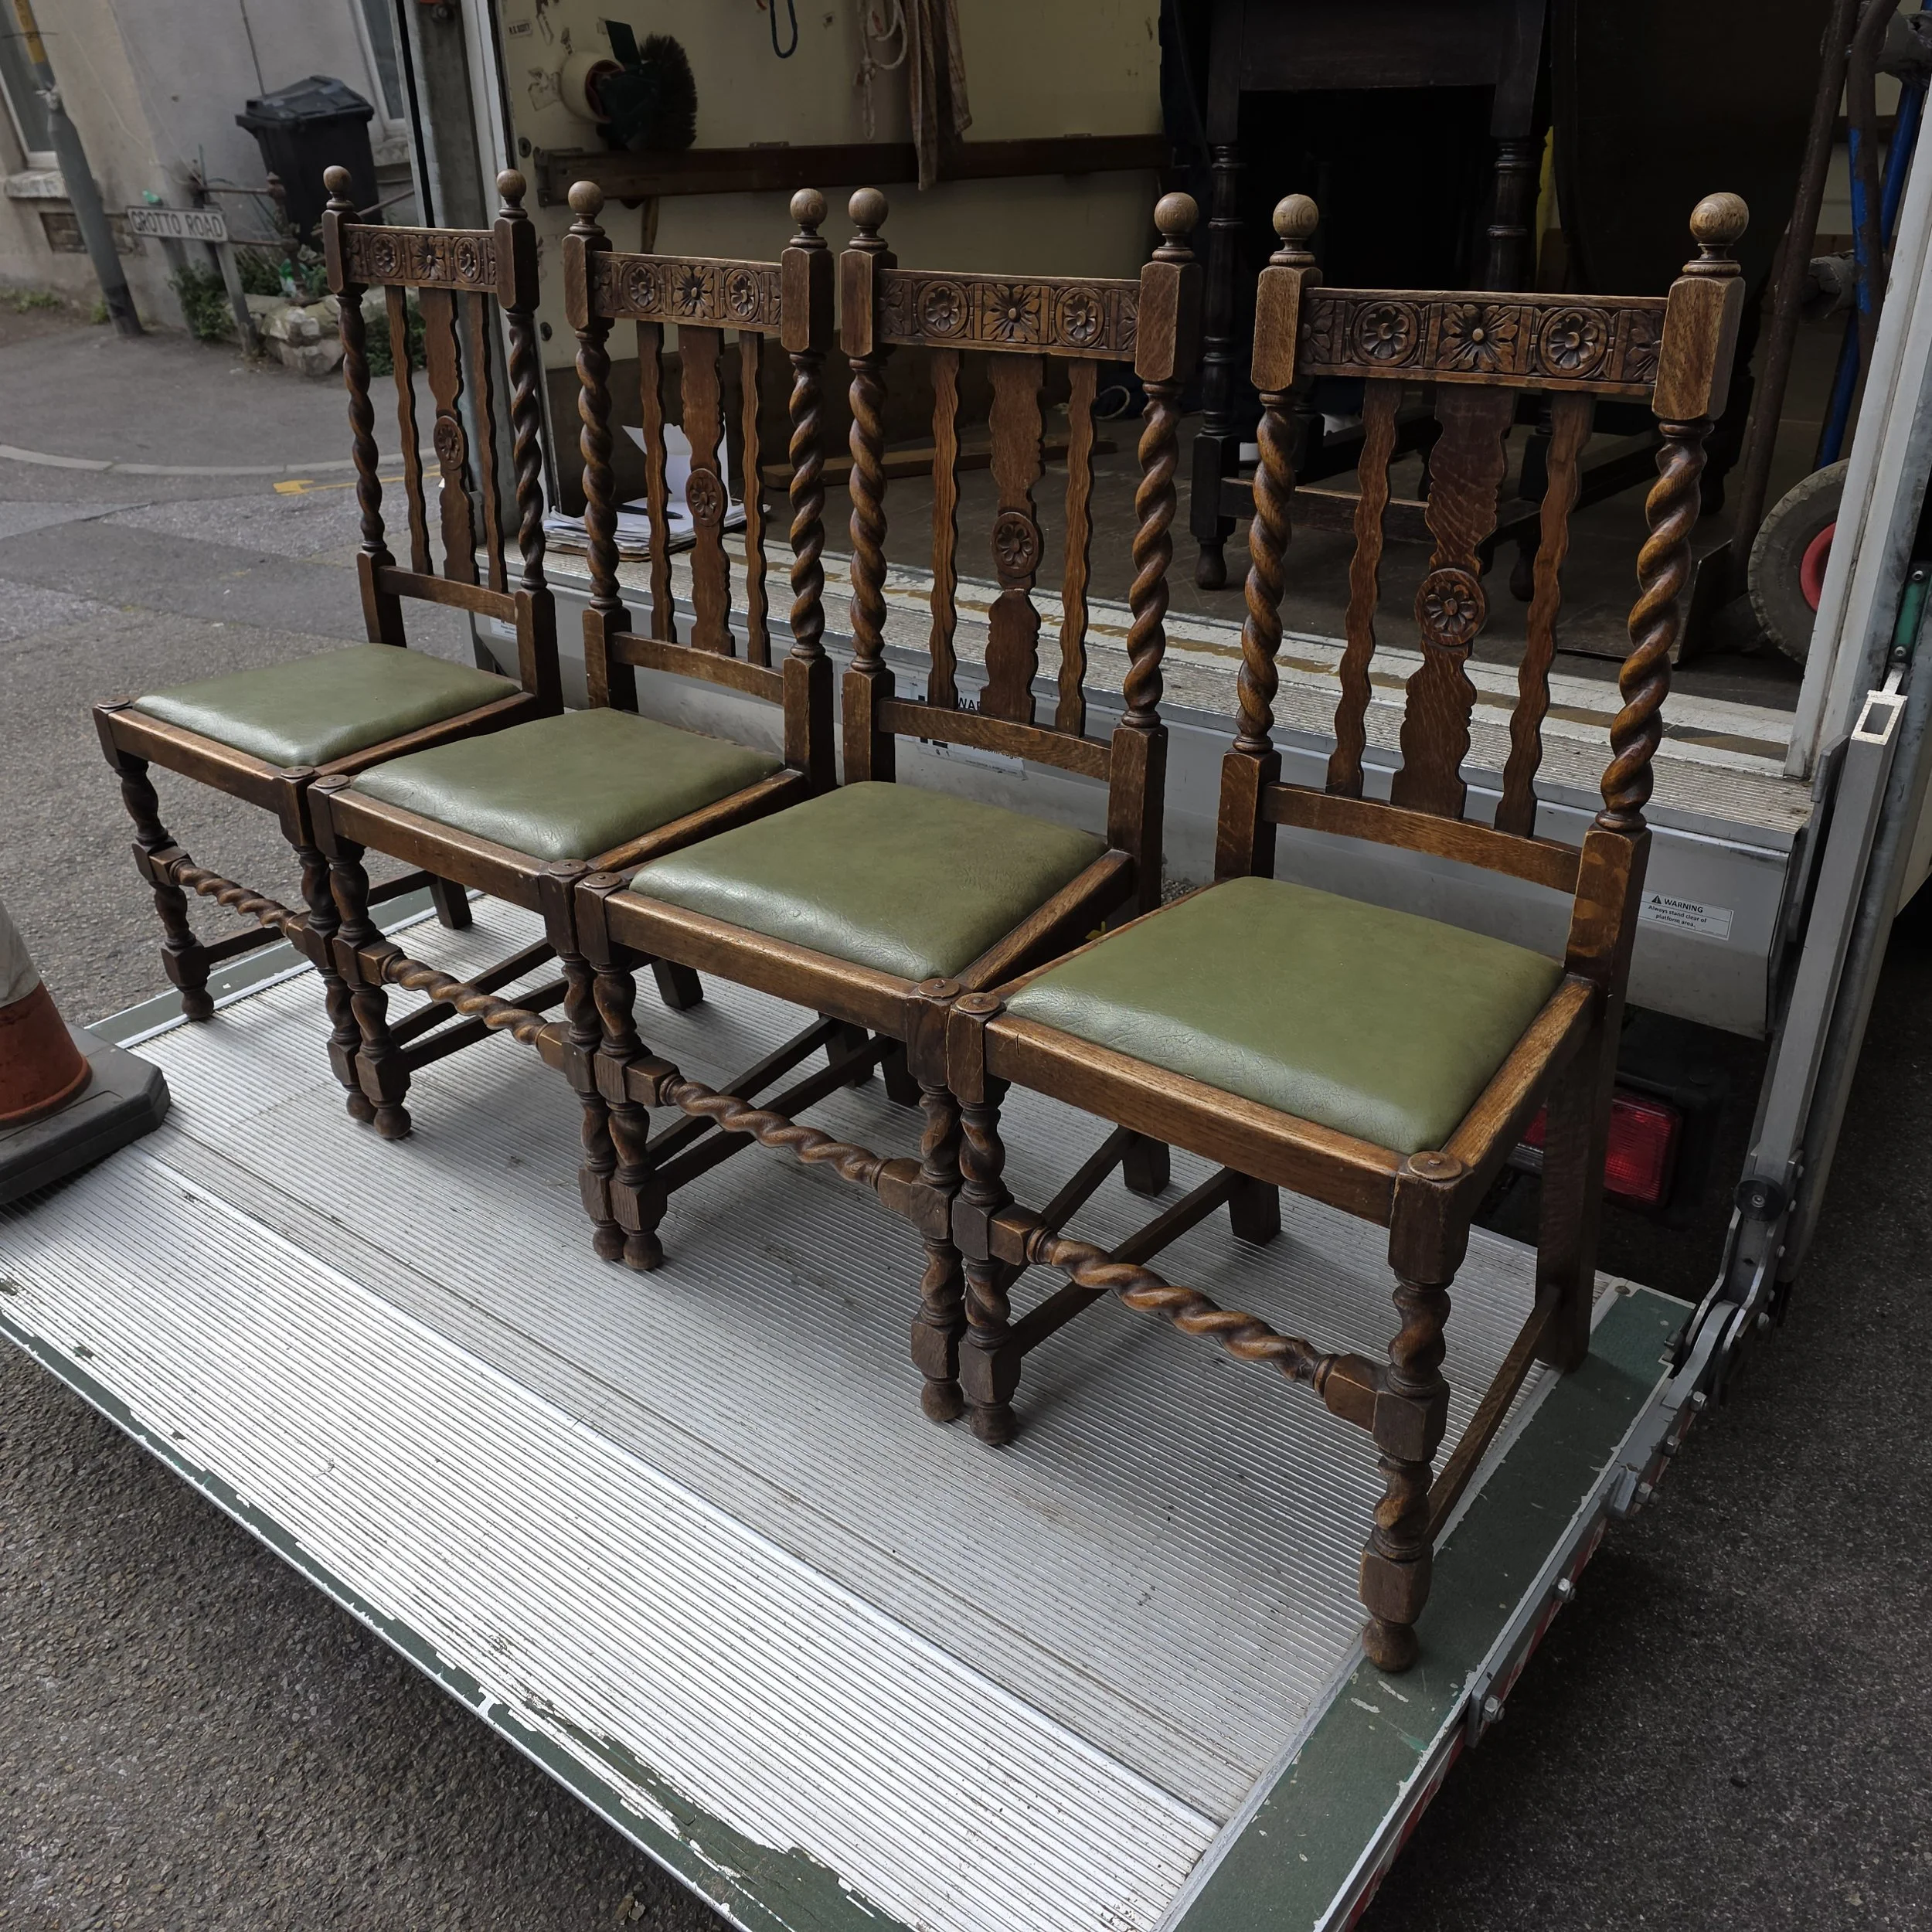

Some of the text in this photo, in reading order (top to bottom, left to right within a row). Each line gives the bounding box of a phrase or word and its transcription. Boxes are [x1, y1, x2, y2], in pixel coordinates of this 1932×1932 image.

[185, 214, 223, 237] ROAD
[1648, 905, 1668, 914] Always
[1668, 910, 1685, 918] stand
[1664, 898, 1703, 913] WARNING
[1655, 913, 1680, 924] platform
